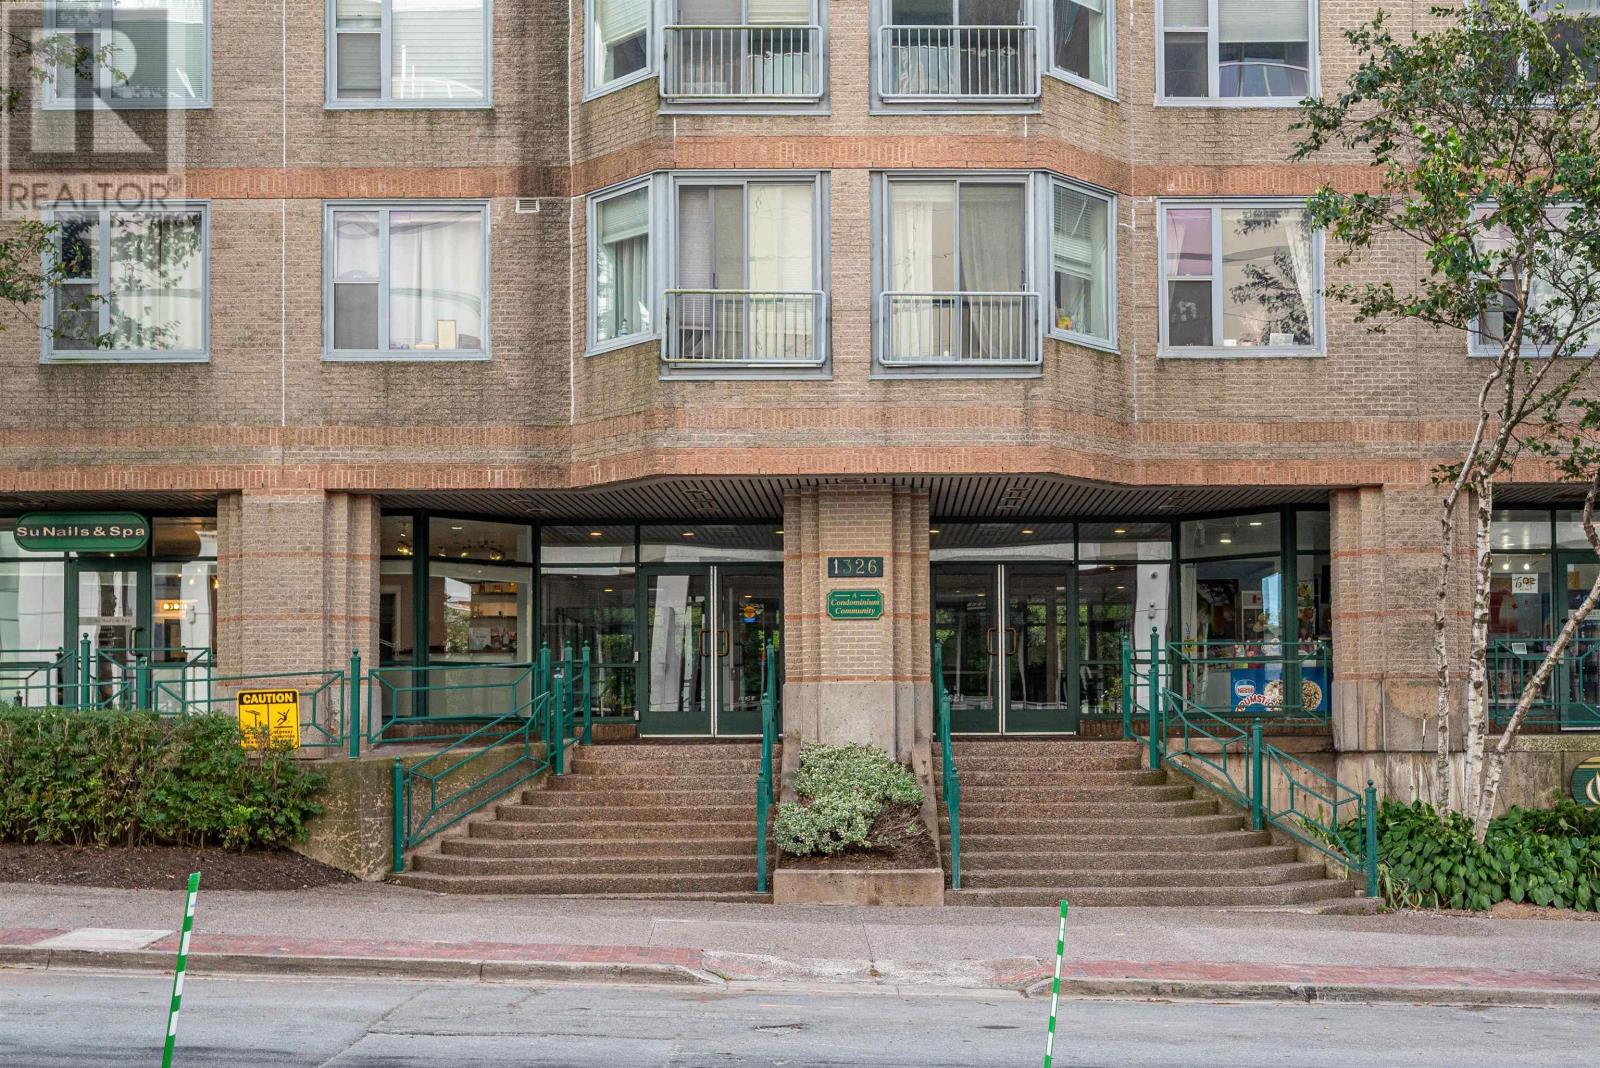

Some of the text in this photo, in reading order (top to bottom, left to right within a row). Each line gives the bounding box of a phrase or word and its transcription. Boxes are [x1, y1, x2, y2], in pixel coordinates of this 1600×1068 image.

[16, 526, 145, 538] Su Nails & Spa
[833, 558, 877, 575] 1326
[830, 598, 880, 606] Condominium
[835, 607, 876, 615] Community
[242, 692, 294, 704] CAUTION
